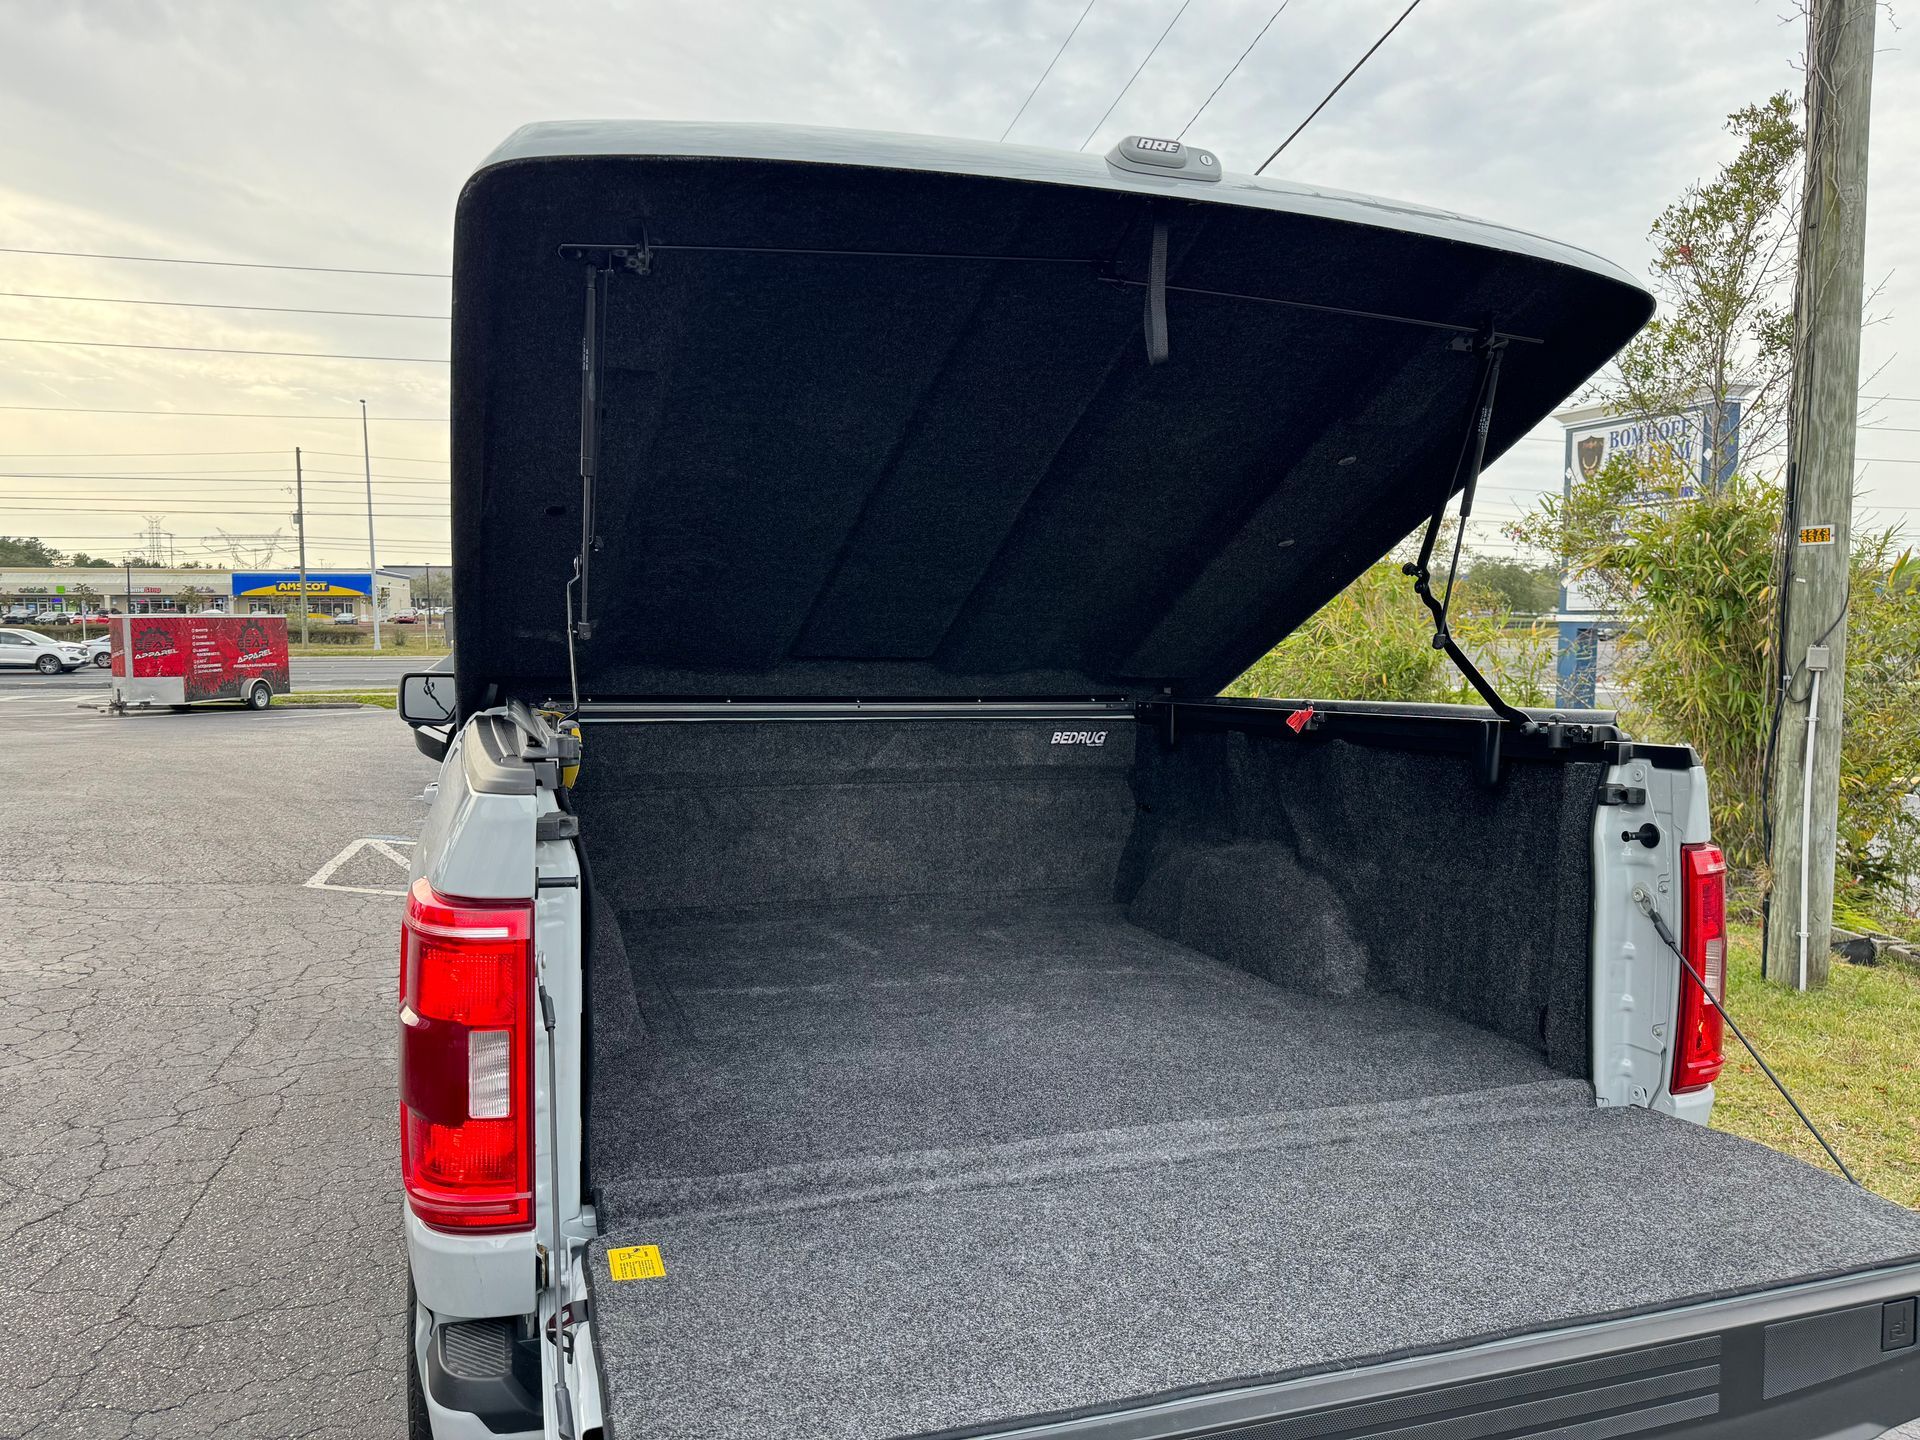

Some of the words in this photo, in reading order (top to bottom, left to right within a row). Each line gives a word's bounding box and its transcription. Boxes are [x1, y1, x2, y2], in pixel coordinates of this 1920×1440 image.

[1137, 138, 1180, 153] ARE
[278, 582, 327, 591] AMSCOT
[134, 649, 178, 660] APPAREL
[237, 649, 273, 663] APPAREL
[1051, 731, 1107, 744] BEDRUG
